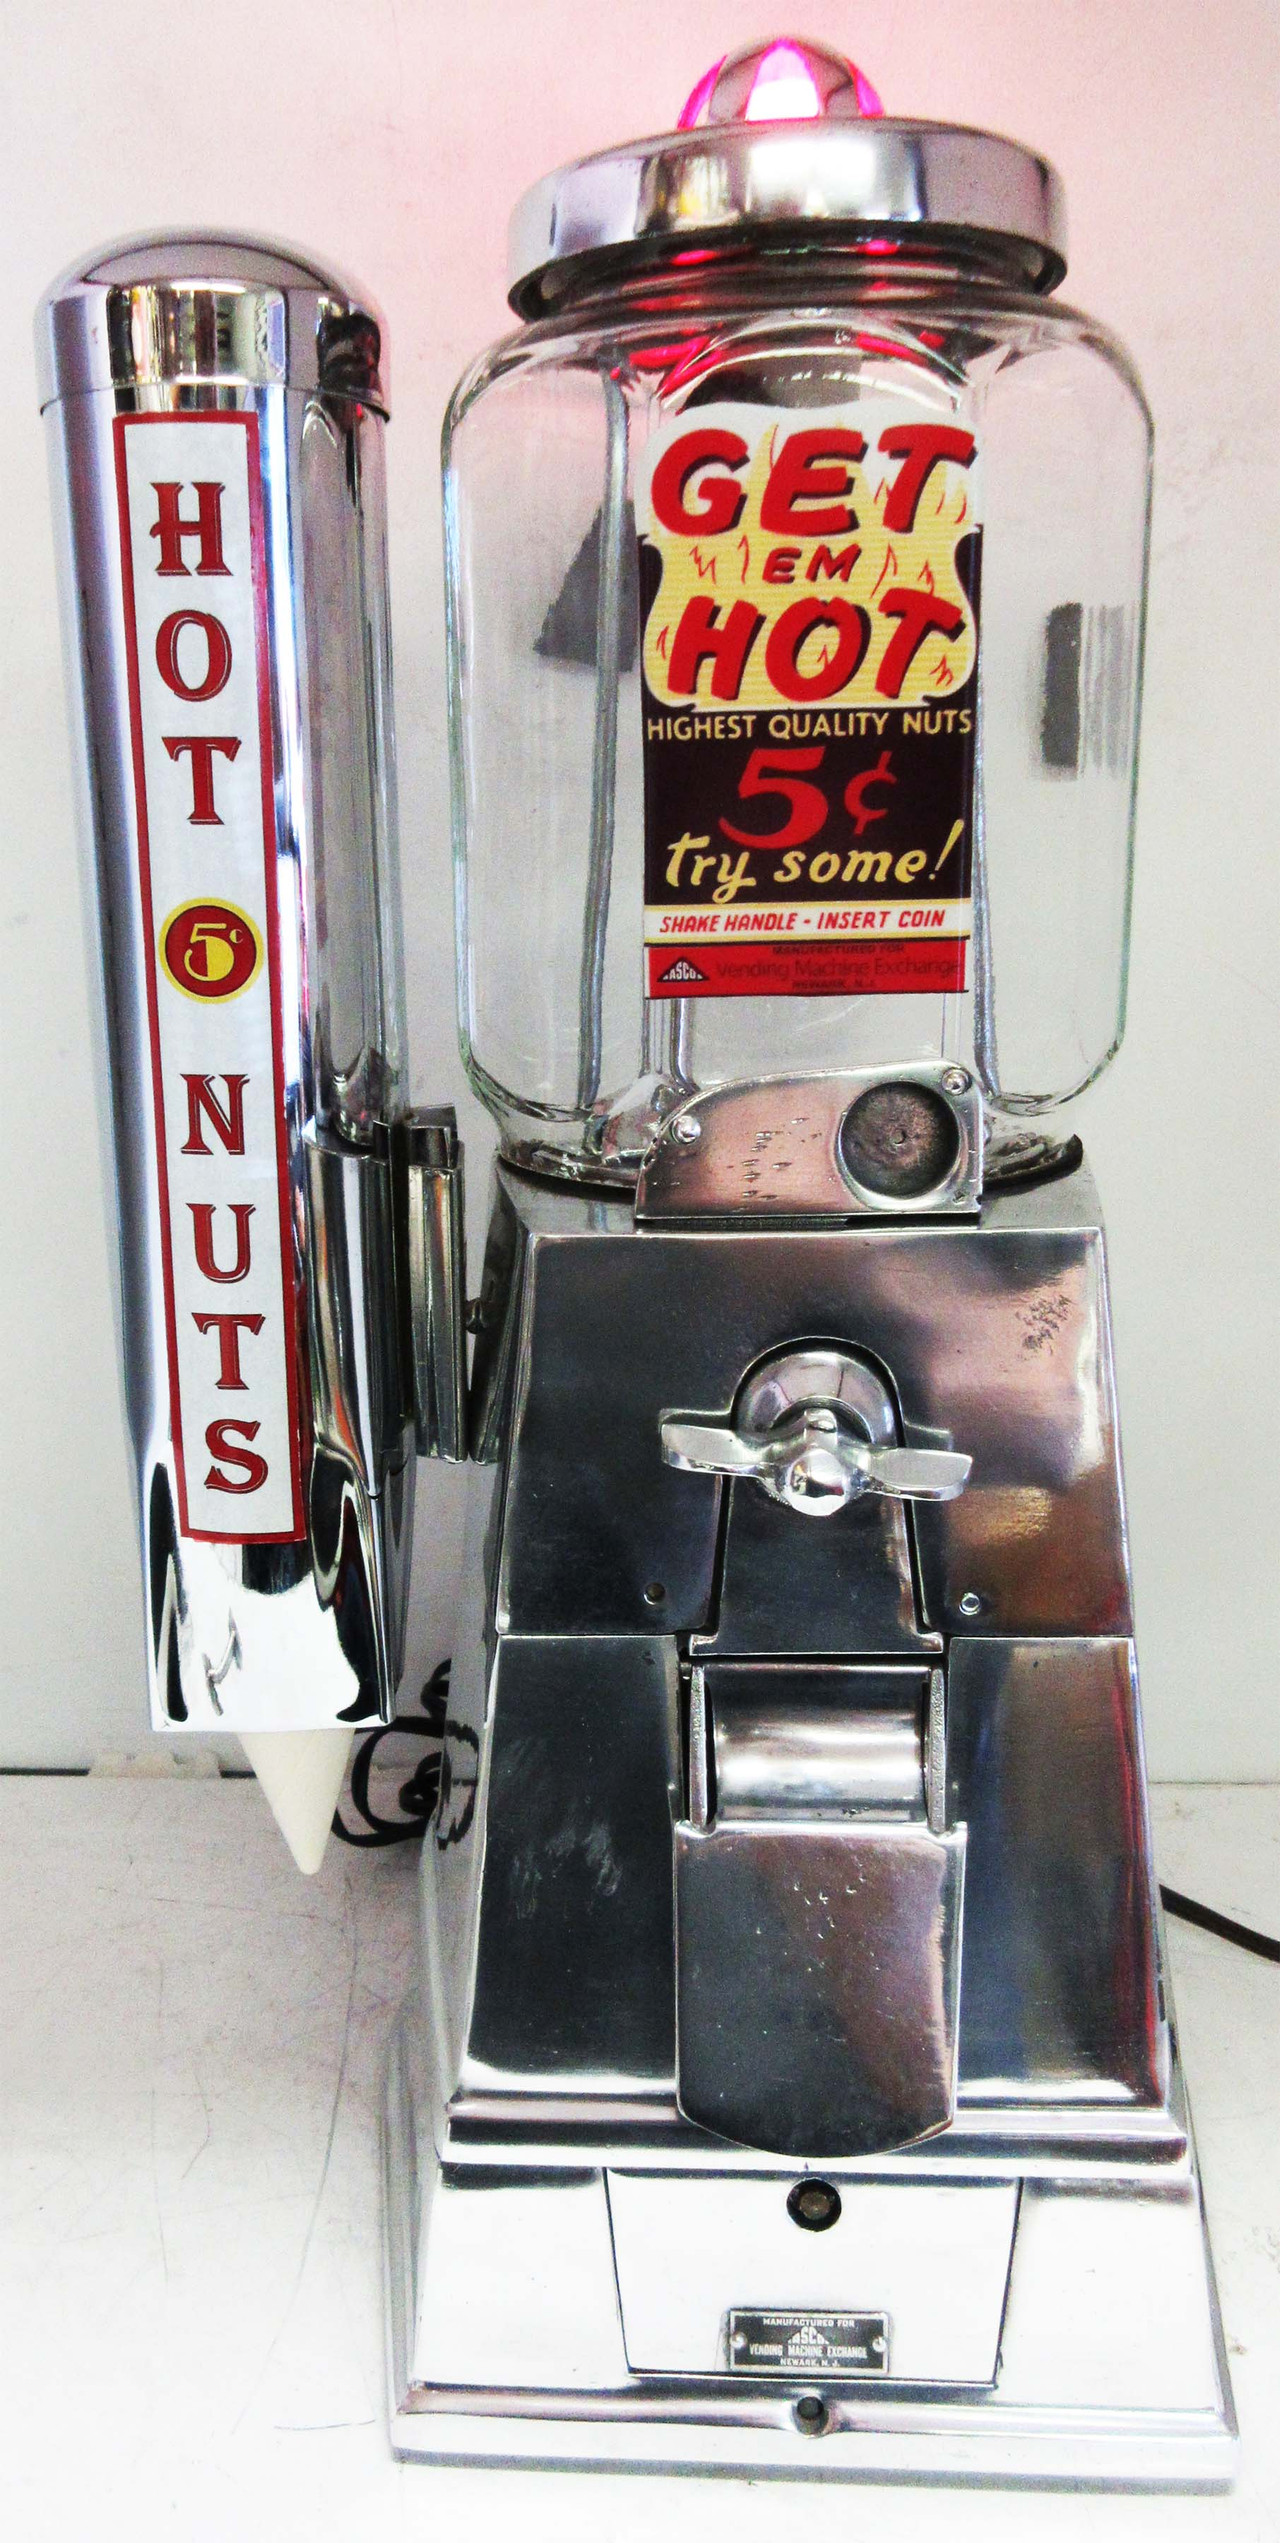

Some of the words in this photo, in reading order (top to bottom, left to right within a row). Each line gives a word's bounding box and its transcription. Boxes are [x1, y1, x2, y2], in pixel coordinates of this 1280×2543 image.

[651, 423, 978, 537] GET
[762, 543, 861, 584] EM
[150, 481, 242, 825] HOT
[667, 588, 966, 702] HOT
[648, 714, 757, 741] HIGHEST
[768, 711, 889, 740] QUALITY
[902, 709, 972, 735] NUTS
[665, 832, 757, 904] try
[773, 819, 965, 884] some!
[659, 915, 719, 933] SHAKE
[725, 912, 799, 932] HANDLE
[816, 911, 888, 930] INSERT
[898, 909, 946, 928] COIN
[716, 961, 791, 981] Vending
[795, 959, 872, 977] Machine
[179, 1073, 269, 1494] NUTS
[763, 2318, 834, 2327] MANUFACTURED
[837, 2319, 856, 2328] FOR
[749, 2344, 784, 2356] VENDING
[787, 2344, 824, 2357] MACHINE
[827, 2345, 868, 2359] EXCHANGE
